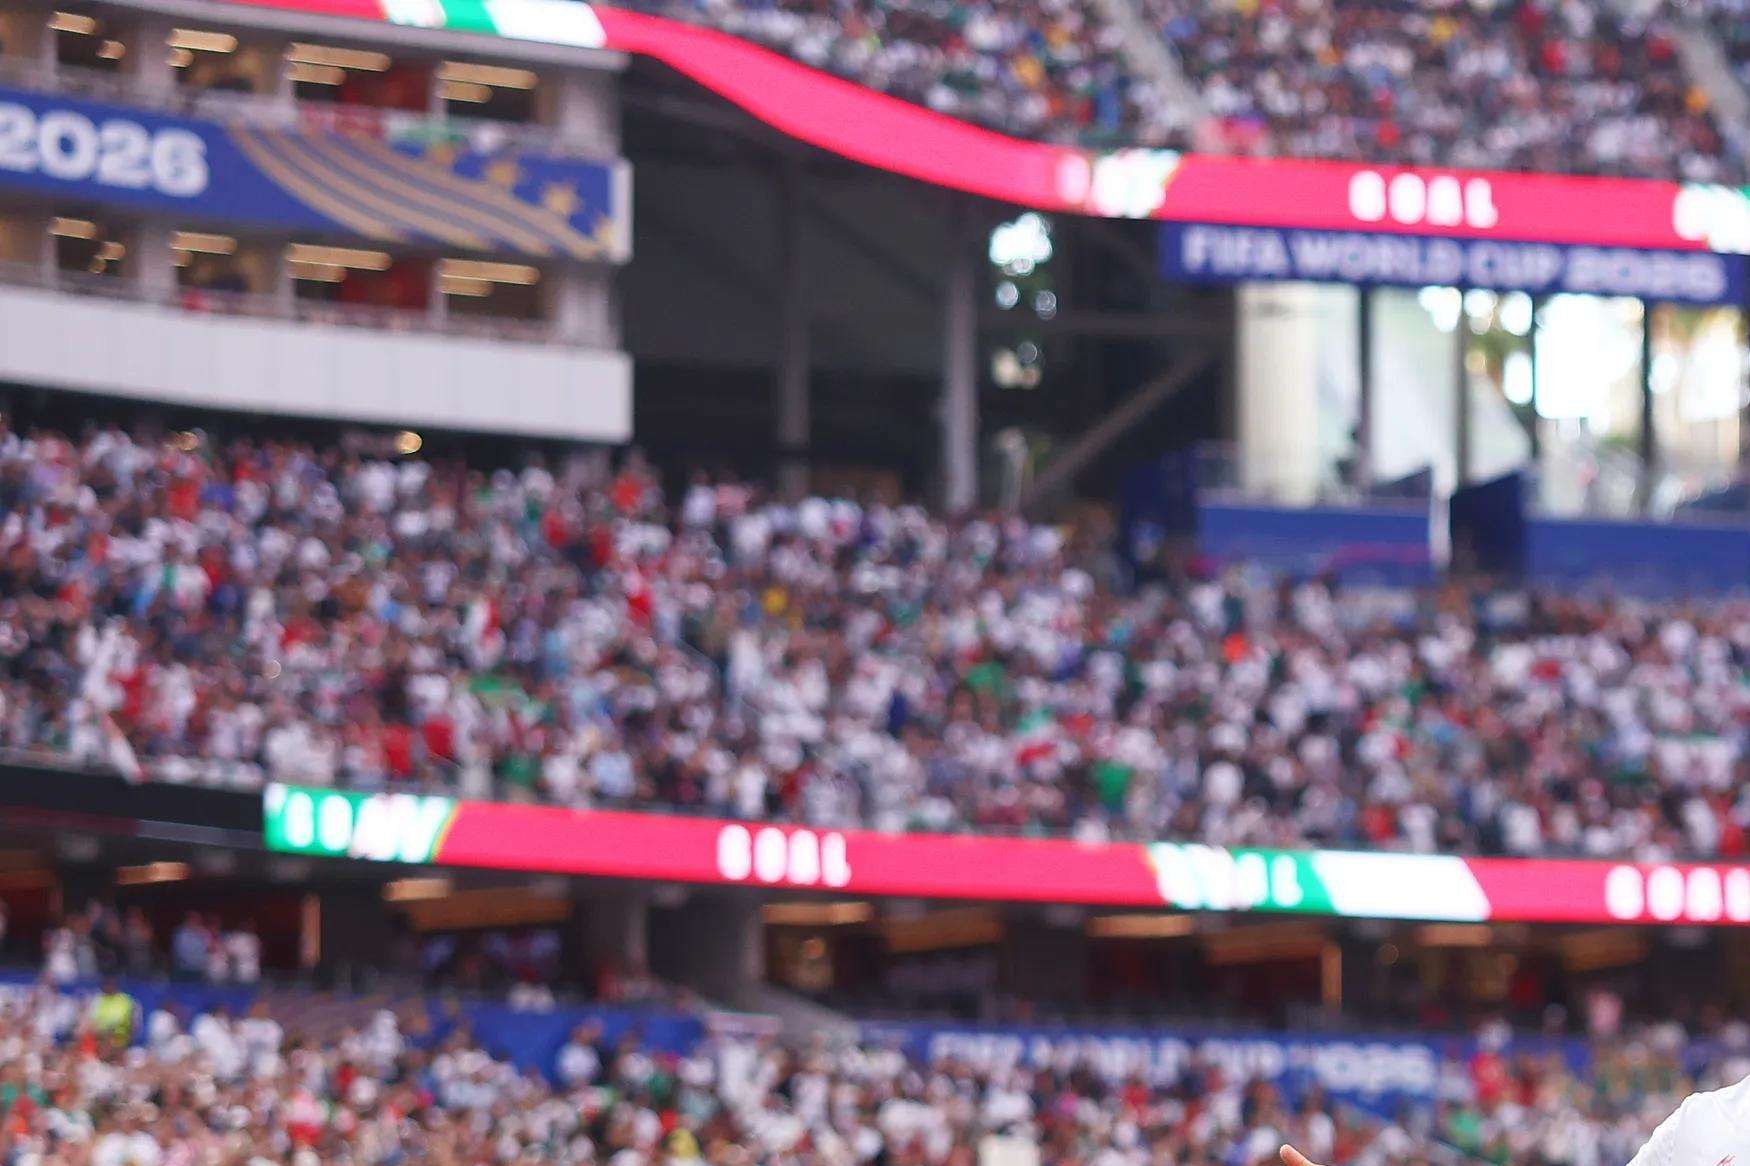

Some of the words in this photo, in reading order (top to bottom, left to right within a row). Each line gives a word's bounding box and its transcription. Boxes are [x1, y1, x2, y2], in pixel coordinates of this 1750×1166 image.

[0, 101, 209, 197] 2026
[1348, 170, 1498, 228] GOAL
[1181, 224, 1290, 276] FIFA
[1291, 231, 1464, 284] WORLD
[1467, 241, 1562, 290] CUP
[717, 824, 852, 887] GOAL
